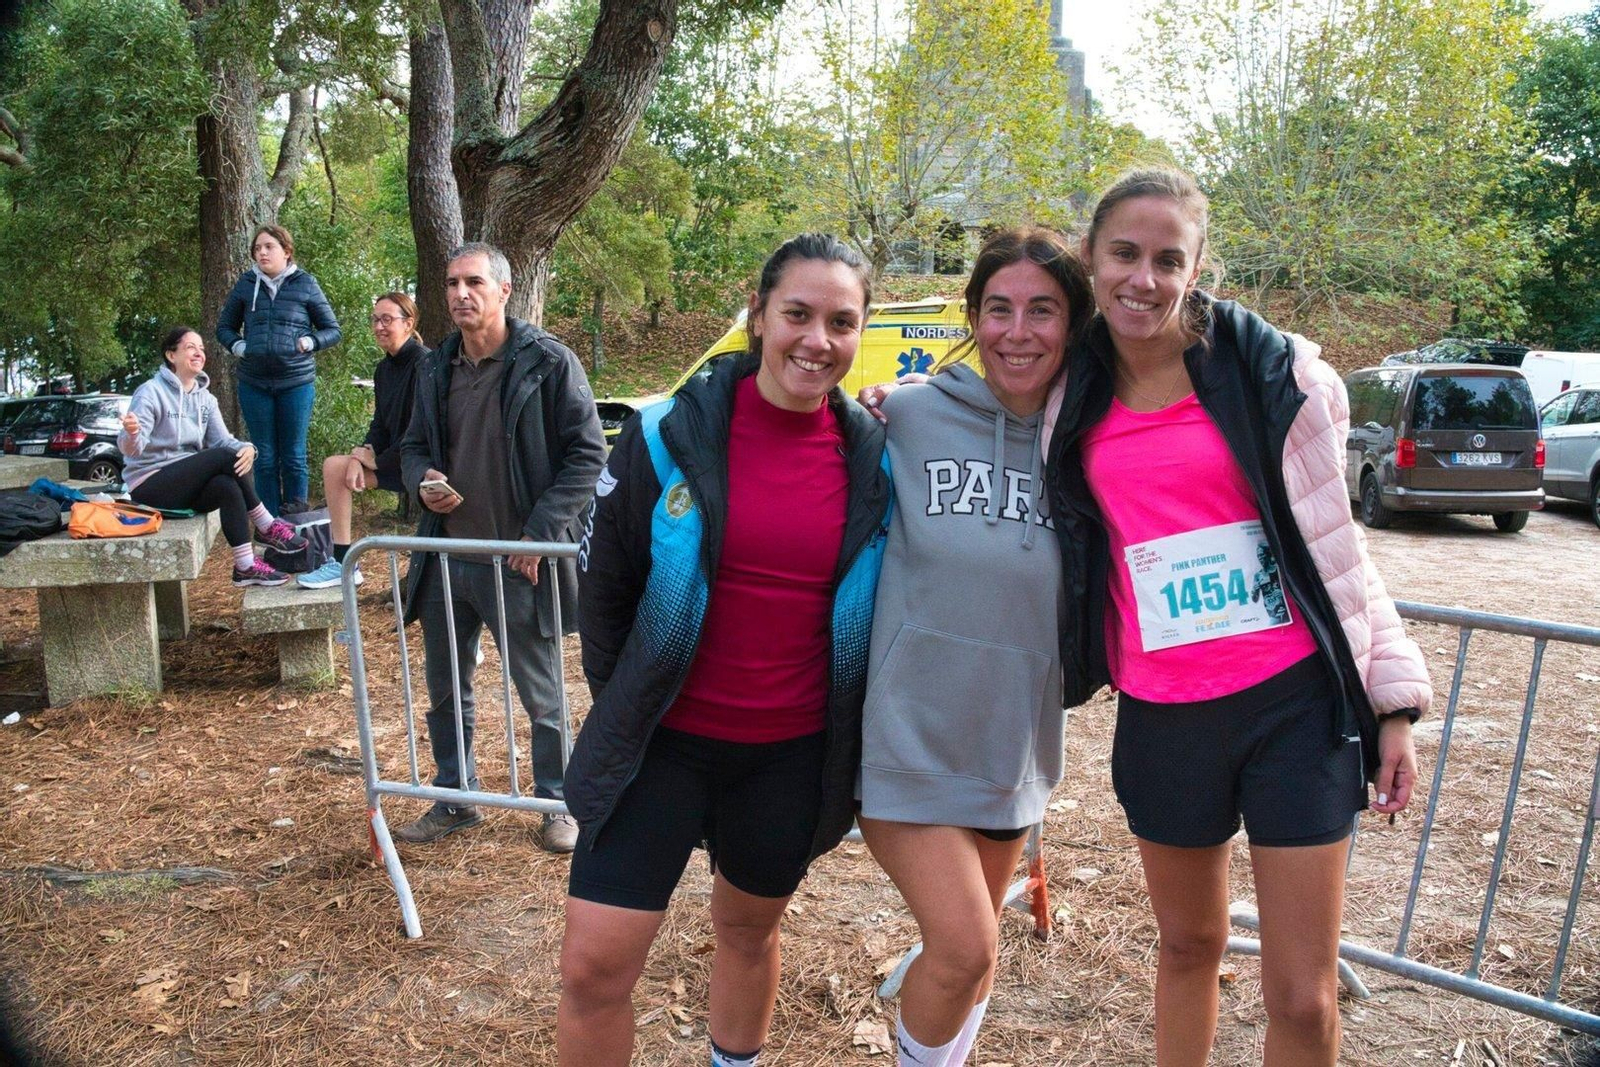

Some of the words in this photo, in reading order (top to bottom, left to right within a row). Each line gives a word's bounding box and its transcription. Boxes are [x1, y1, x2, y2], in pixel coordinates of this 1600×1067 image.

[906, 328, 966, 338] NORDES
[925, 459, 1055, 530] PAR
[1171, 560, 1191, 572] PINK
[1191, 554, 1226, 567] PANTHER
[1160, 569, 1249, 618] 1454
